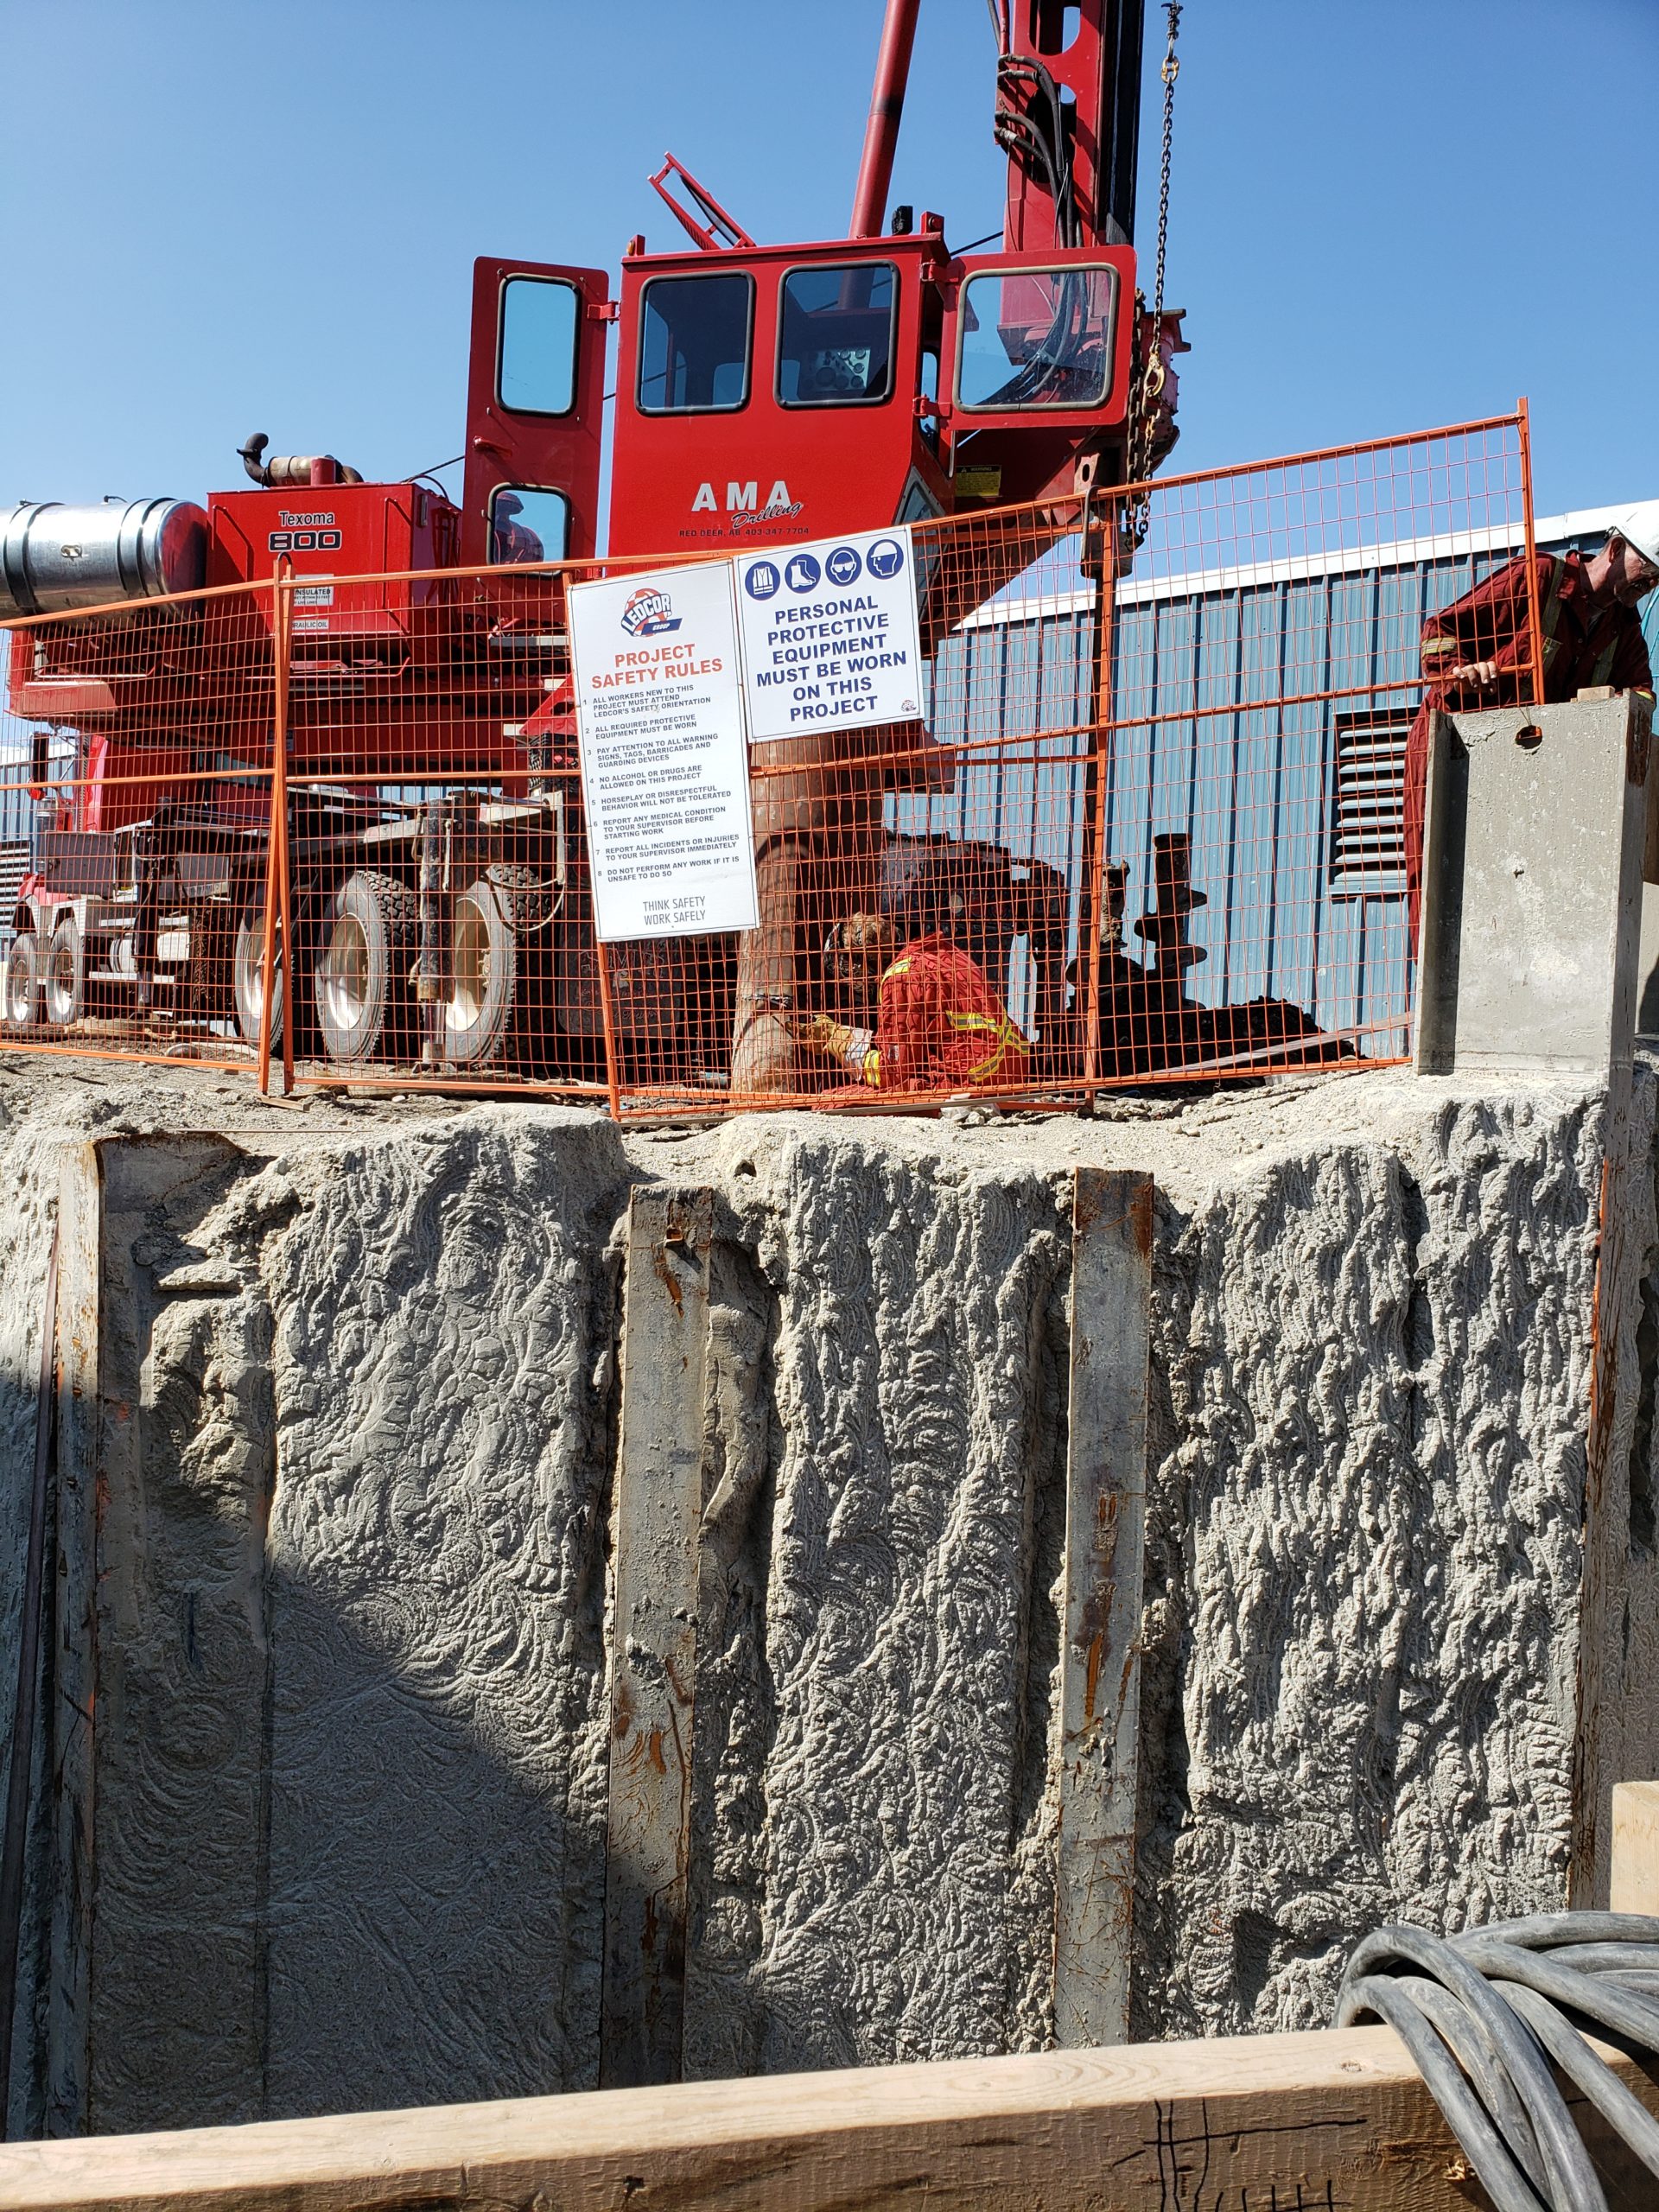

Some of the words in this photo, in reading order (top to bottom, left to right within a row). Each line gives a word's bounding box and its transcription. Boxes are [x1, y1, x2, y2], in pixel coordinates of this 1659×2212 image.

[691, 480, 792, 512] AMA
[278, 511, 335, 526] Texoma
[731, 501, 804, 529] Drilling
[269, 530, 342, 552] 800
[621, 595, 671, 632] LEDCOR
[775, 596, 878, 625] PERSONAL
[768, 613, 888, 645] PROTECTIVE
[615, 644, 695, 667] PROJECT
[772, 634, 887, 664] EQUIPMENT
[592, 667, 658, 689] SAFETY
[665, 658, 722, 678] RULES
[757, 666, 810, 687] MUST
[817, 661, 841, 677] BE
[848, 651, 906, 672] WORN
[608, 692, 644, 702] WORKERS
[793, 684, 820, 701] ON
[827, 677, 872, 696] THIS
[594, 702, 626, 711] PROJECT
[652, 694, 679, 703] ATTEND
[594, 709, 629, 718] LEDCOR'S
[632, 704, 659, 713] SAFETY
[662, 696, 710, 709] ORIENTATION
[791, 696, 877, 721] PROJECT
[611, 721, 647, 730] REQUIRED
[650, 714, 696, 725] PROTECTIVE
[596, 729, 638, 740] EQUIPMENT
[613, 742, 653, 753] ATTENTION
[683, 734, 718, 743] WARNING
[647, 744, 693, 755] BARRICADES
[598, 759, 636, 768] GUARDING
[639, 754, 669, 763] DEVICES
[601, 781, 633, 790] ALLOWED
[668, 772, 701, 781] PROJECT
[612, 772, 645, 781] ALCOHOL
[601, 794, 643, 804] HORSEPLAY
[658, 785, 717, 798] DISRESPECTFUL
[602, 802, 639, 811] BEHAVIOR
[688, 791, 731, 801] TOLERATED
[603, 817, 631, 826] REPORT
[651, 811, 683, 820] MEDICAL
[685, 806, 726, 817] CONDITION
[637, 819, 683, 829] SUPERVISOR
[685, 815, 714, 823] BEFORE
[604, 831, 639, 840] STARTING
[652, 840, 690, 849] INCIDENTS
[705, 834, 739, 843] INJURIES
[639, 848, 685, 857] SUPERVISOR
[688, 842, 736, 852] IMMEDIATELY
[636, 863, 671, 873] PERFORM
[643, 899, 670, 912] THINK
[673, 896, 705, 909] SAFETY
[645, 913, 670, 925] WORK
[674, 910, 705, 922] SAFELY
